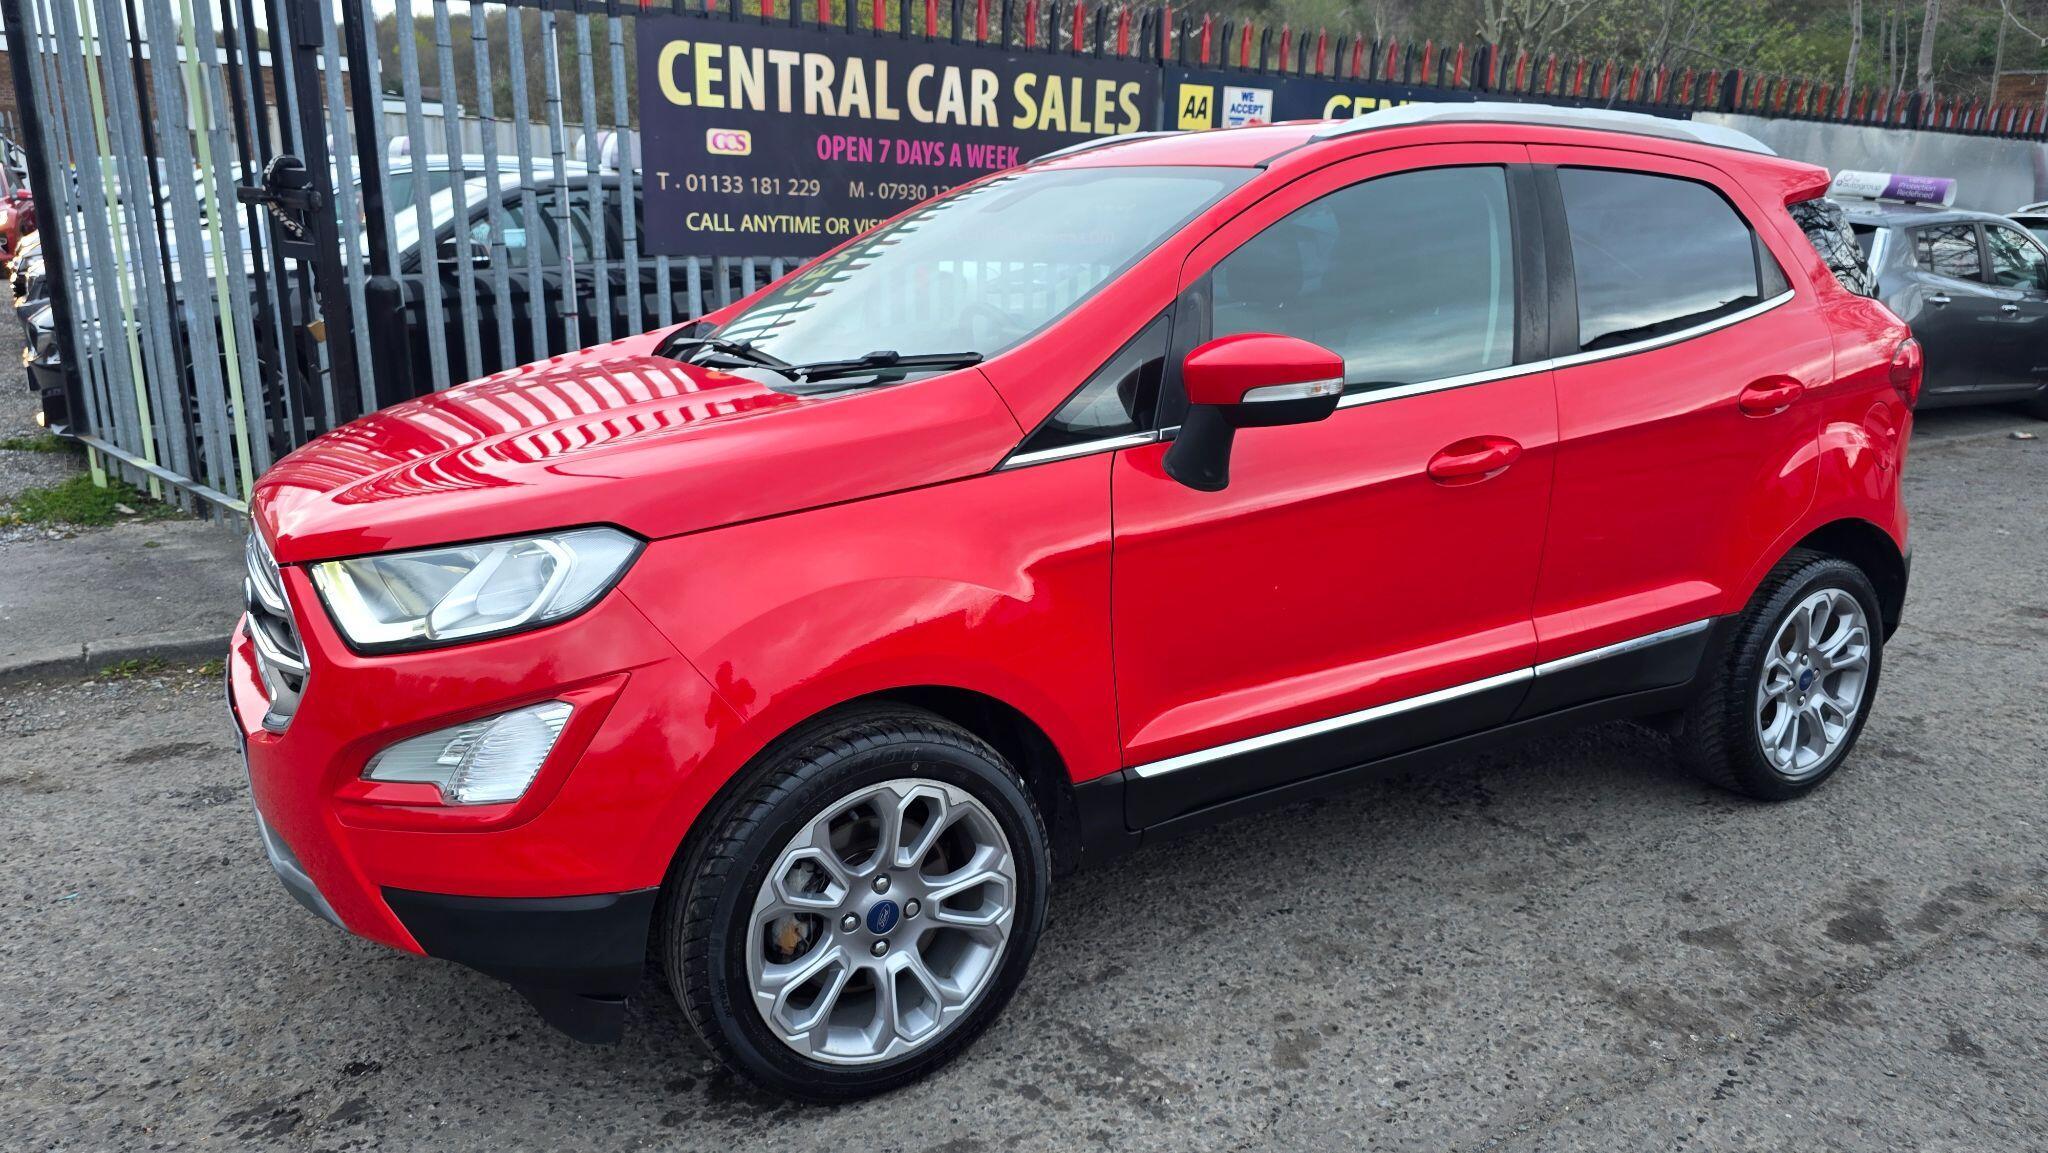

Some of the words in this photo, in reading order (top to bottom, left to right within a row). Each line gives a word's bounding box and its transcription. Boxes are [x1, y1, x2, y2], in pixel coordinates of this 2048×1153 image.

[657, 39, 900, 121] CENTRAL
[906, 63, 999, 128] CAR
[1012, 72, 1141, 135] SALES
[1241, 92, 1254, 102] WE
[1183, 95, 1207, 120] AA
[1230, 103, 1264, 115] ACCEPT
[816, 134, 873, 163] OPEN
[878, 139, 891, 164] 7
[896, 139, 945, 166] DAYS
[949, 142, 962, 168] A
[966, 143, 1020, 169] WEEK
[685, 173, 744, 194] 01133
[750, 176, 781, 195] 181
[787, 178, 821, 197] 229
[878, 182, 927, 201] 07930
[1896, 187, 1935, 199] Redefined
[686, 212, 735, 232] CALL
[740, 214, 821, 235] ANYTIME
[825, 217, 850, 236] OR
[853, 218, 888, 235] VIS
